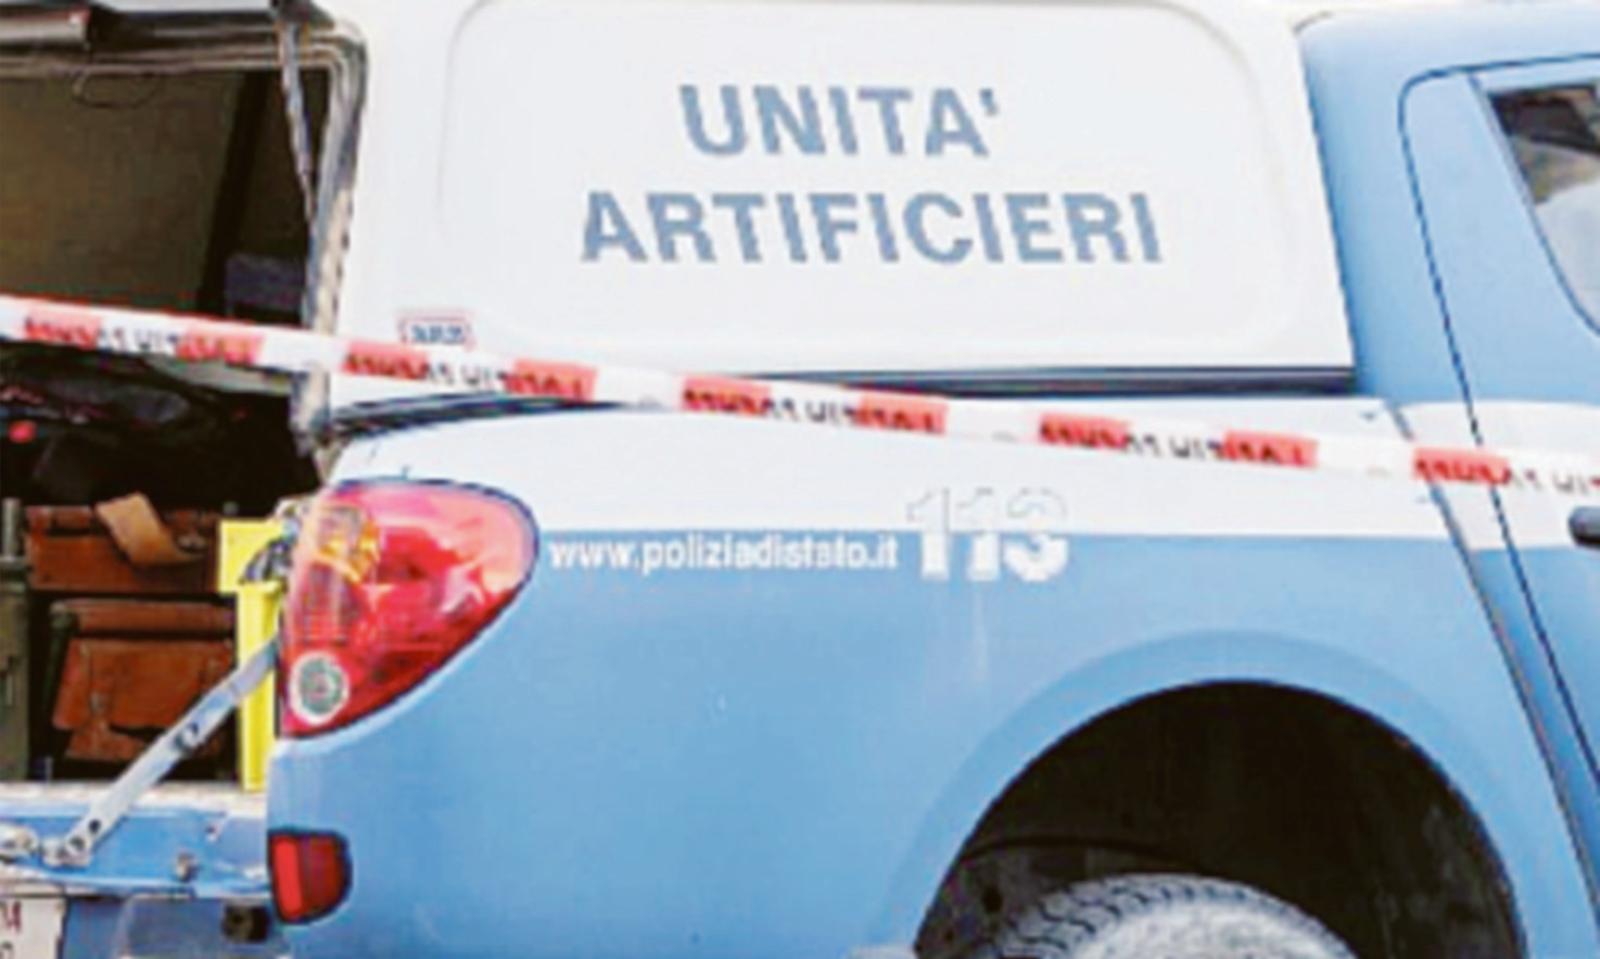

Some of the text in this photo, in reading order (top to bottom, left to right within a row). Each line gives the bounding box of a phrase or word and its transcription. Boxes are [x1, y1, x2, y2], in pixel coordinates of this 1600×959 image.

[679, 84, 1000, 157] UNITA'
[580, 190, 1163, 265] ARTIFICIERI
[548, 534, 898, 574] www.poliziadistato.it
[906, 486, 1070, 583] 113
